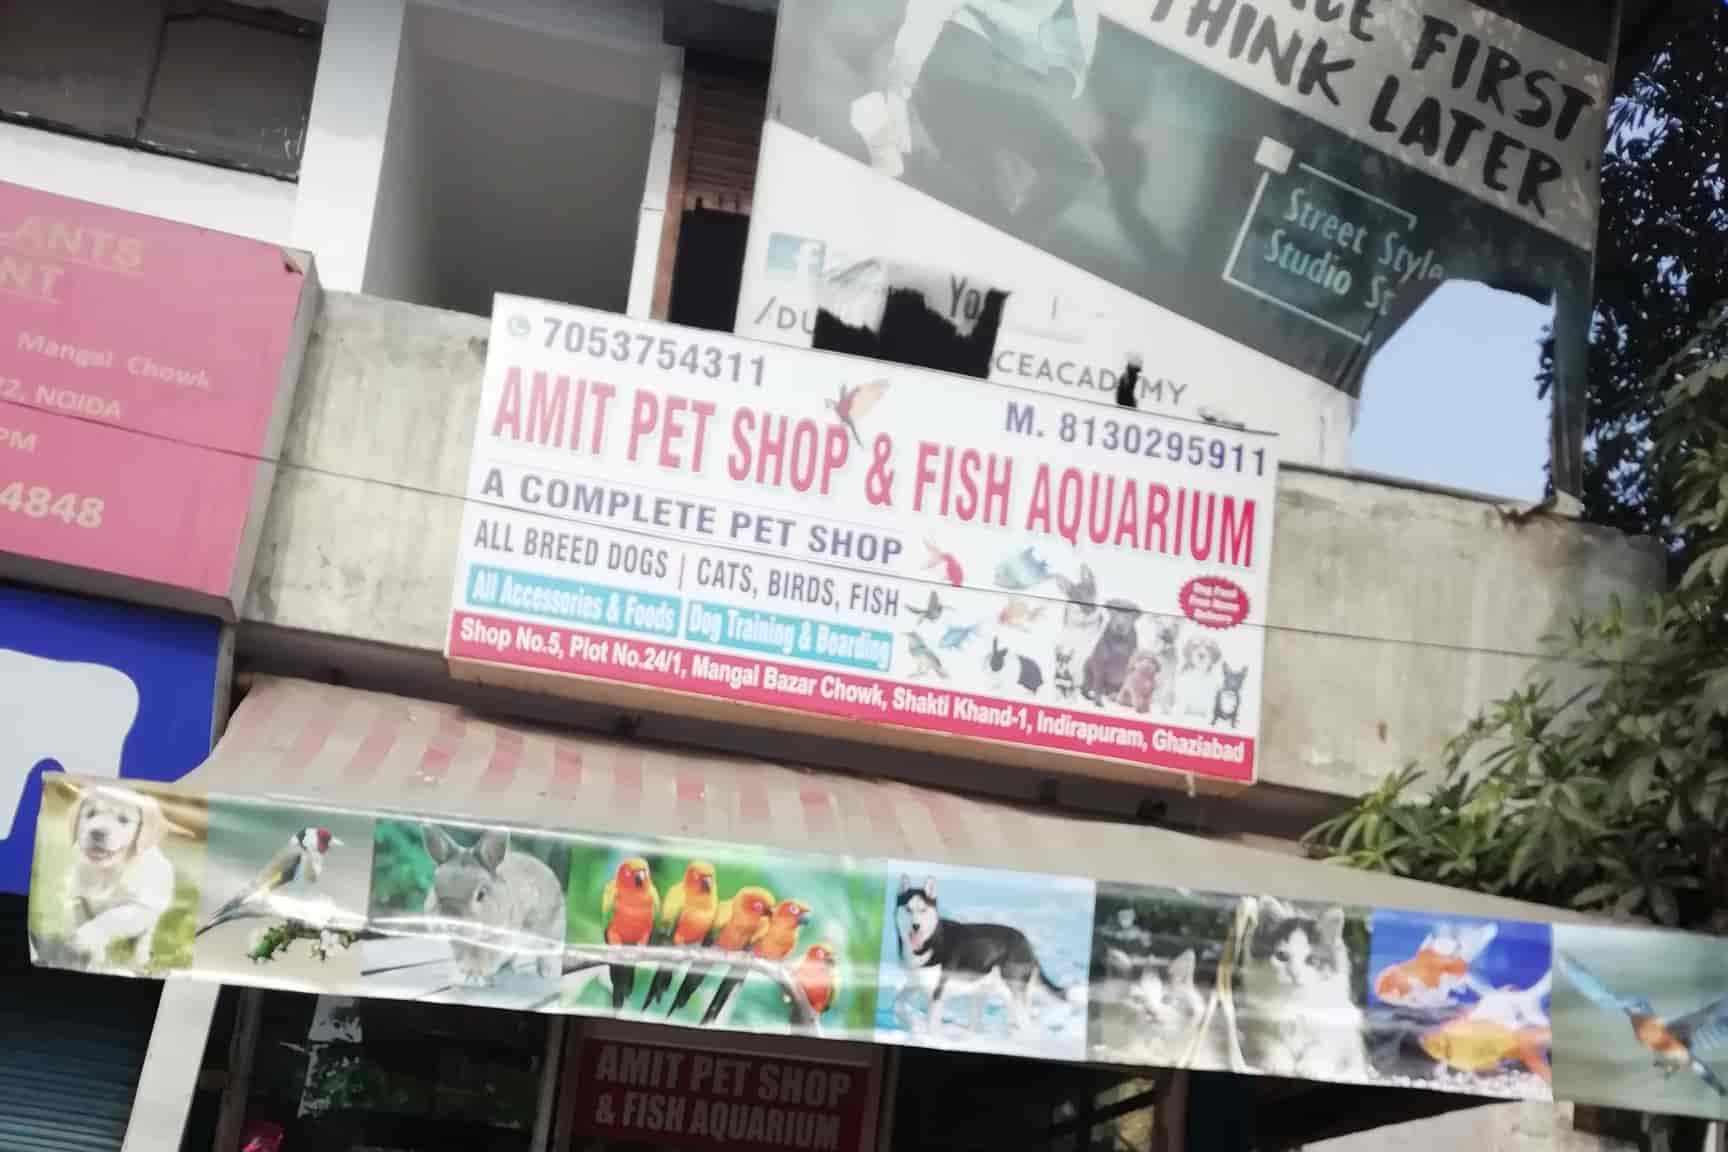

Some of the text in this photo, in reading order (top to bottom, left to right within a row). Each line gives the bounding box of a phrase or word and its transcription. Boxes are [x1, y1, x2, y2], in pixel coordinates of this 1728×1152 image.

[1411, 14, 1596, 142] FIRST
[1369, 74, 1562, 217] LATER
[1283, 187, 1369, 255] Street
[1264, 228, 1353, 296] Studio
[17, 330, 212, 391] Mangal Chowk
[543, 317, 765, 387] 7053754311
[35, 383, 121, 420] NOIDA
[492, 365, 1257, 568] AMIT PET SHOP & FISH AQUARIUM
[1004, 400, 1266, 477] M. 8130295911
[480, 468, 903, 564] A COMPLETE PET SHOP
[472, 567, 499, 602] All
[500, 575, 603, 621] Accessories
[474, 518, 900, 616] ALL BREED DOGS CATS, BIRDS, FISH
[727, 609, 795, 655] Training
[460, 618, 511, 652] Shop
[570, 635, 608, 662] Plot
[691, 655, 760, 688] Mangal
[763, 666, 817, 696] Bazar
[820, 675, 887, 710] Chowk,
[891, 687, 950, 716] Shakti
[1037, 714, 1148, 751] Indirapuram,
[1152, 730, 1245, 764] Ghaziabad
[595, 1045, 851, 1108] AMIT PET SHOP
[595, 1091, 841, 1151] & FISH AQUARIUM
